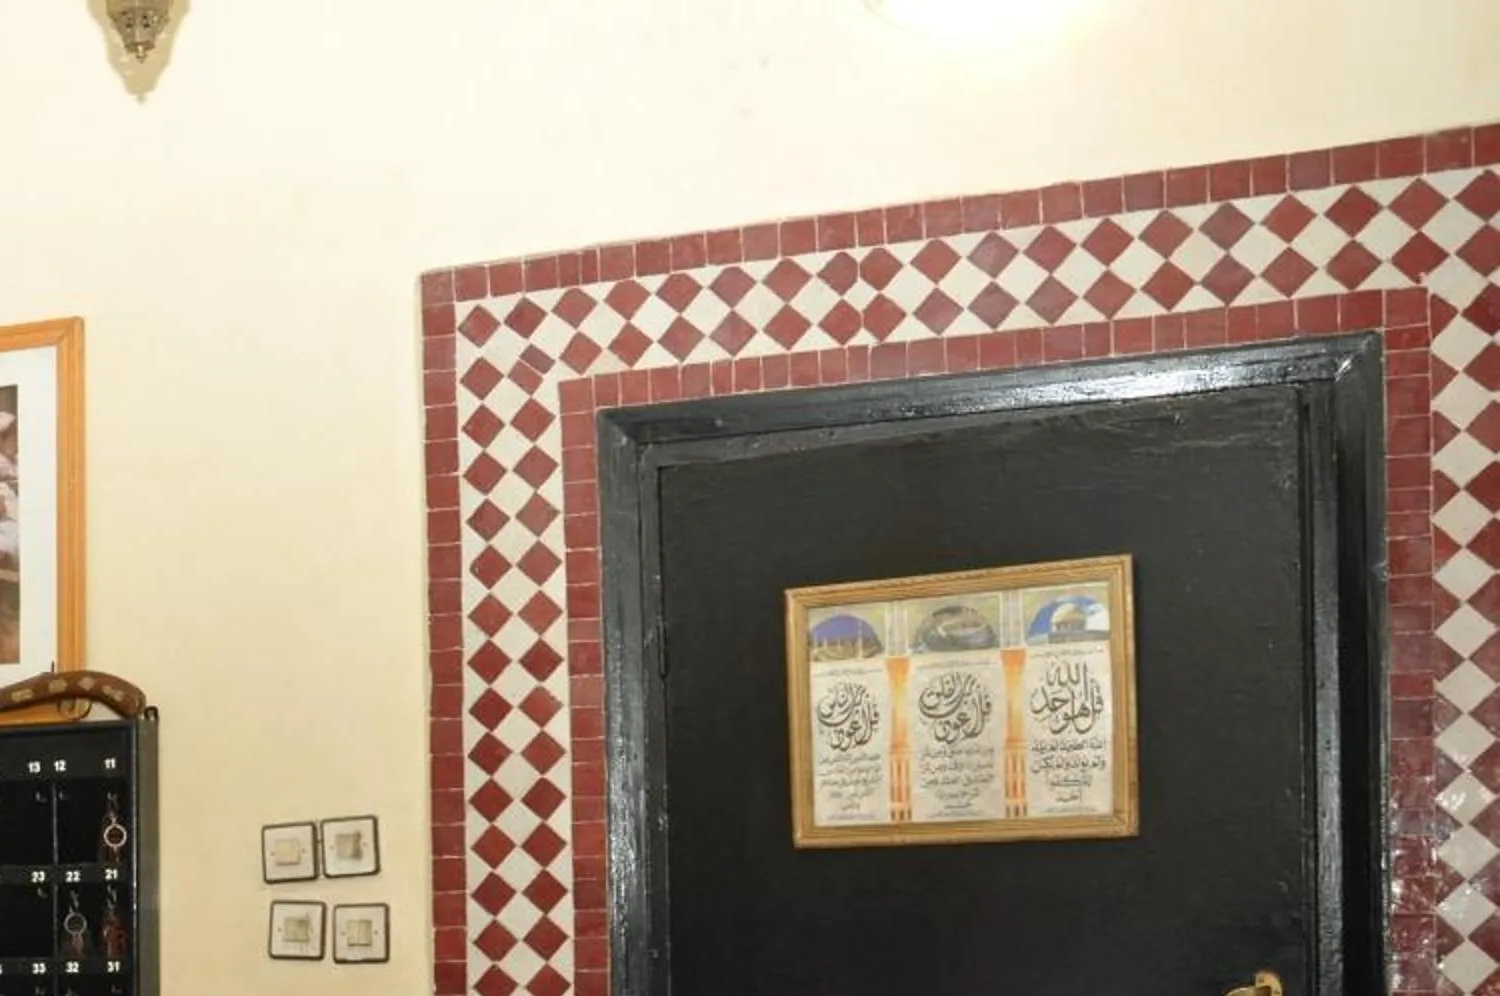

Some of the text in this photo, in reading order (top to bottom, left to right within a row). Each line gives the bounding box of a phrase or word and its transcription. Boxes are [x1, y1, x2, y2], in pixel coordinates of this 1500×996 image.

[27, 761, 41, 773] 13
[53, 759, 67, 772] 12
[104, 757, 116, 769] 11
[31, 870, 46, 883] 23
[65, 870, 81, 883] 22
[105, 868, 118, 880] 21
[32, 962, 47, 975] 33
[65, 961, 80, 973] 32
[107, 961, 120, 973] 31
